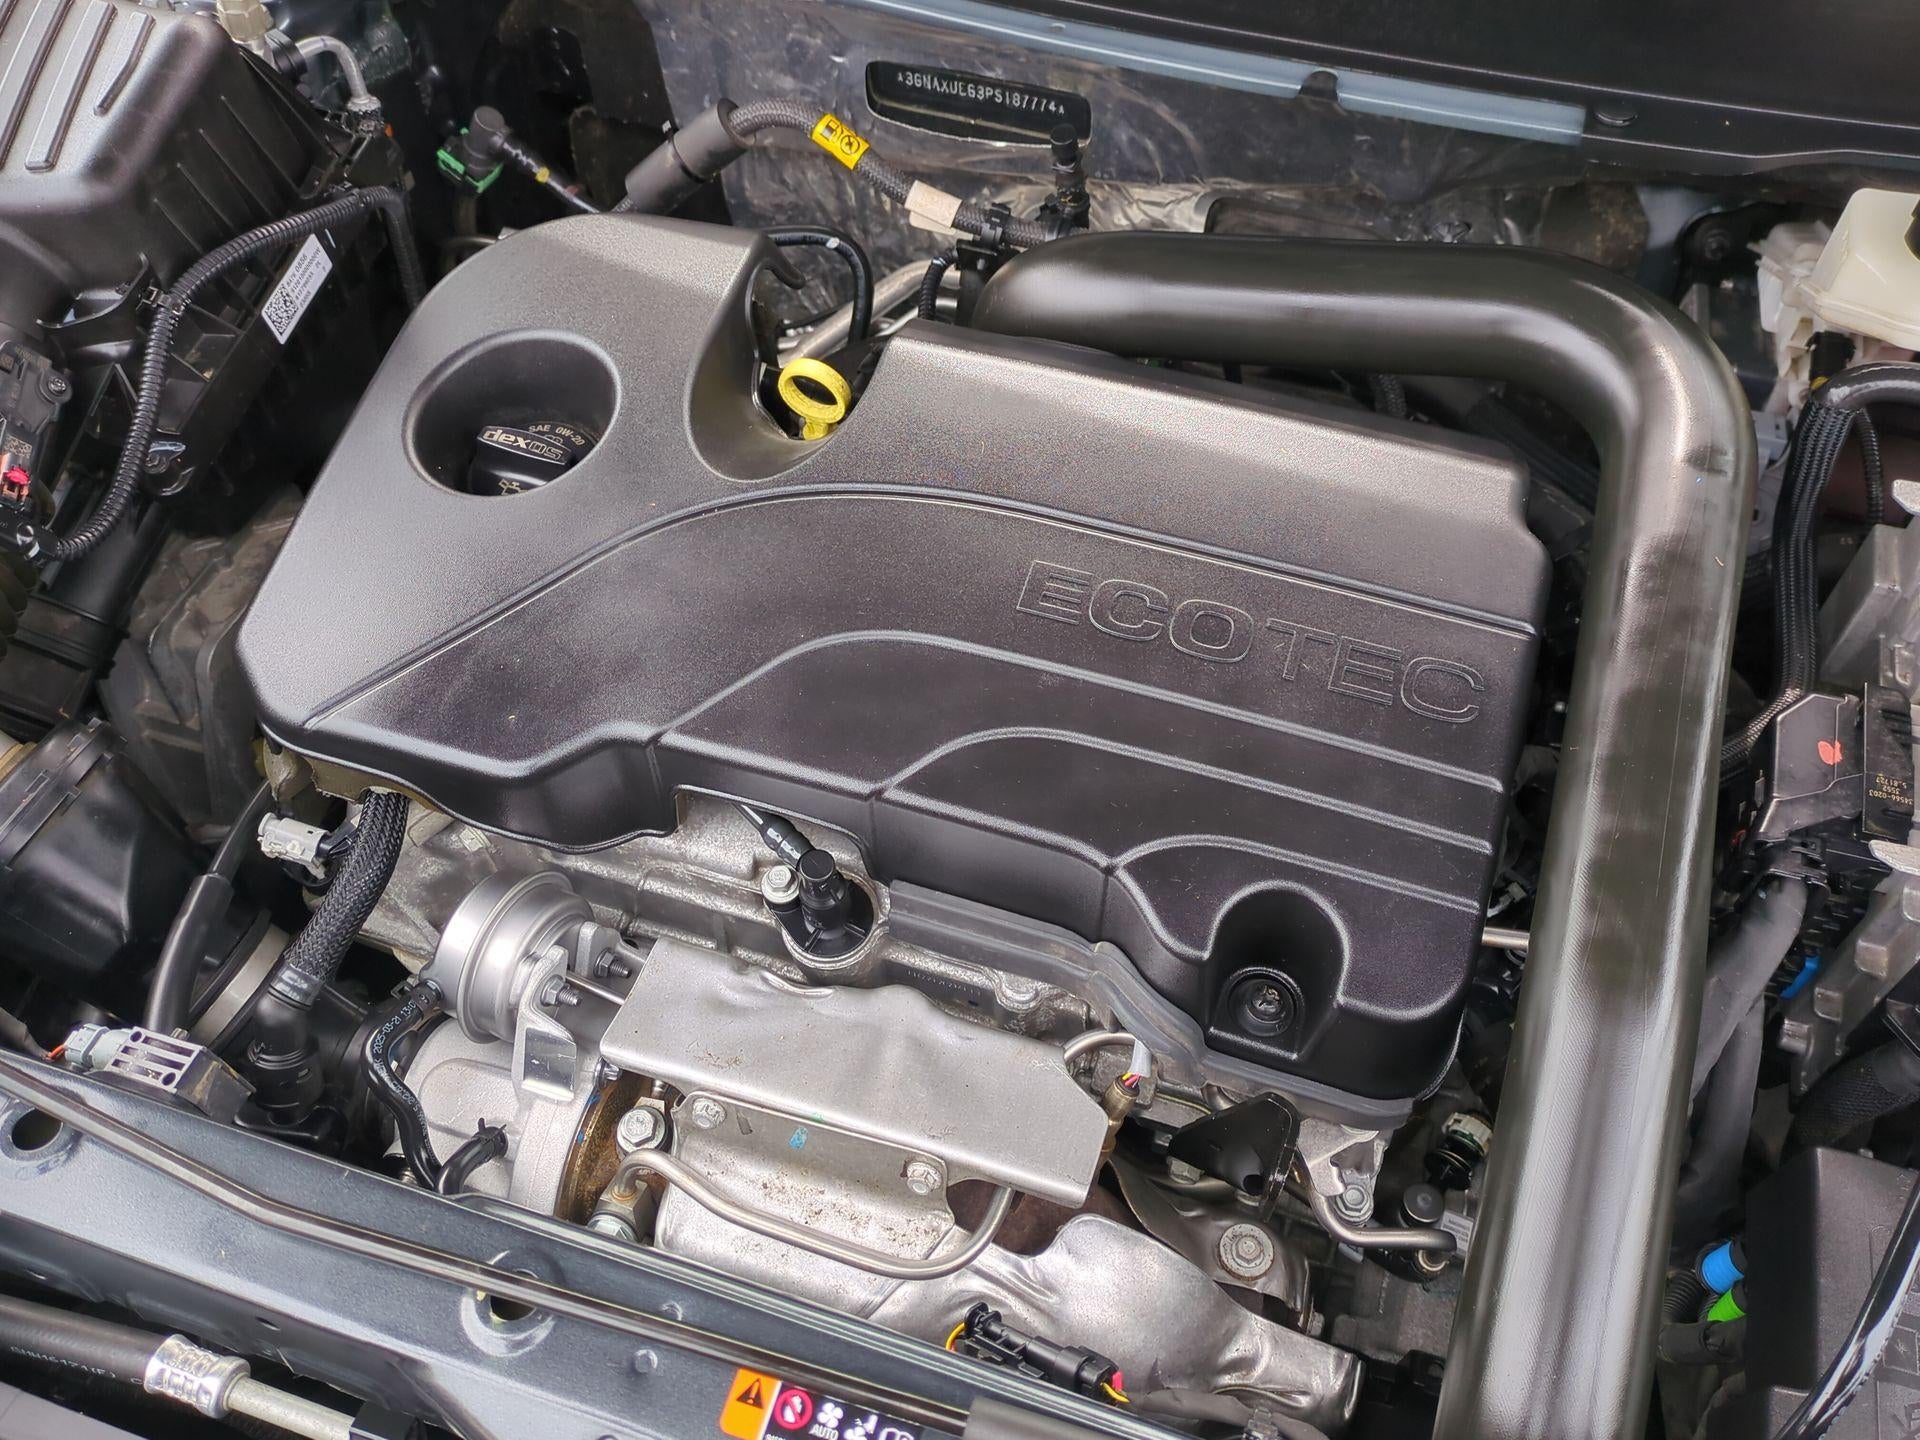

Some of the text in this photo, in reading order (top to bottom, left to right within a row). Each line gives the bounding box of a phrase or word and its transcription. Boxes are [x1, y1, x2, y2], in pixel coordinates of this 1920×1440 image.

[528, 424, 552, 433] SAE
[482, 429, 564, 460] dexos
[1016, 560, 1485, 723] ECOTEC
